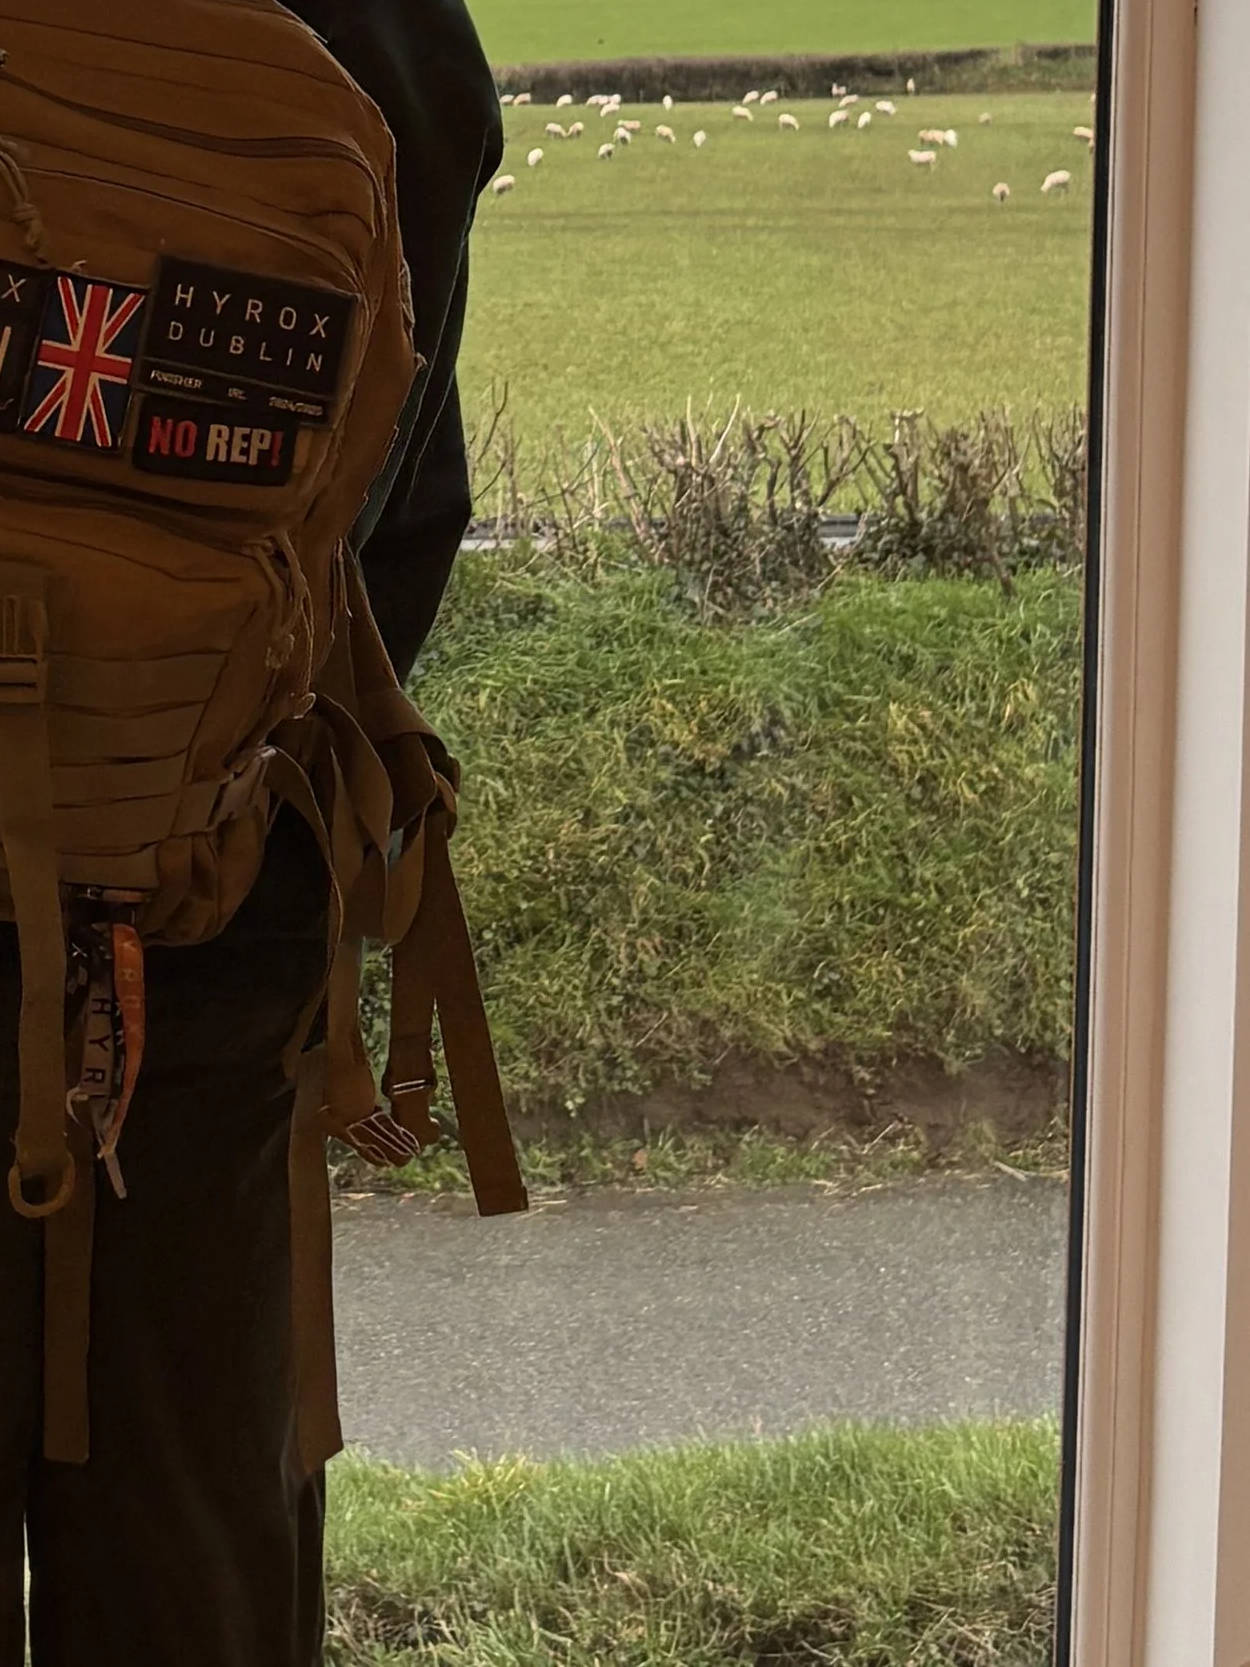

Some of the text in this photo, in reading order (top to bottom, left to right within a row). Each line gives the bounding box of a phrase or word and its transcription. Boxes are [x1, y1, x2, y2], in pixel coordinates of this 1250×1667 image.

[174, 283, 330, 338] HYROX
[168, 320, 323, 372] DUBLIN
[148, 415, 283, 466] NO REP!
